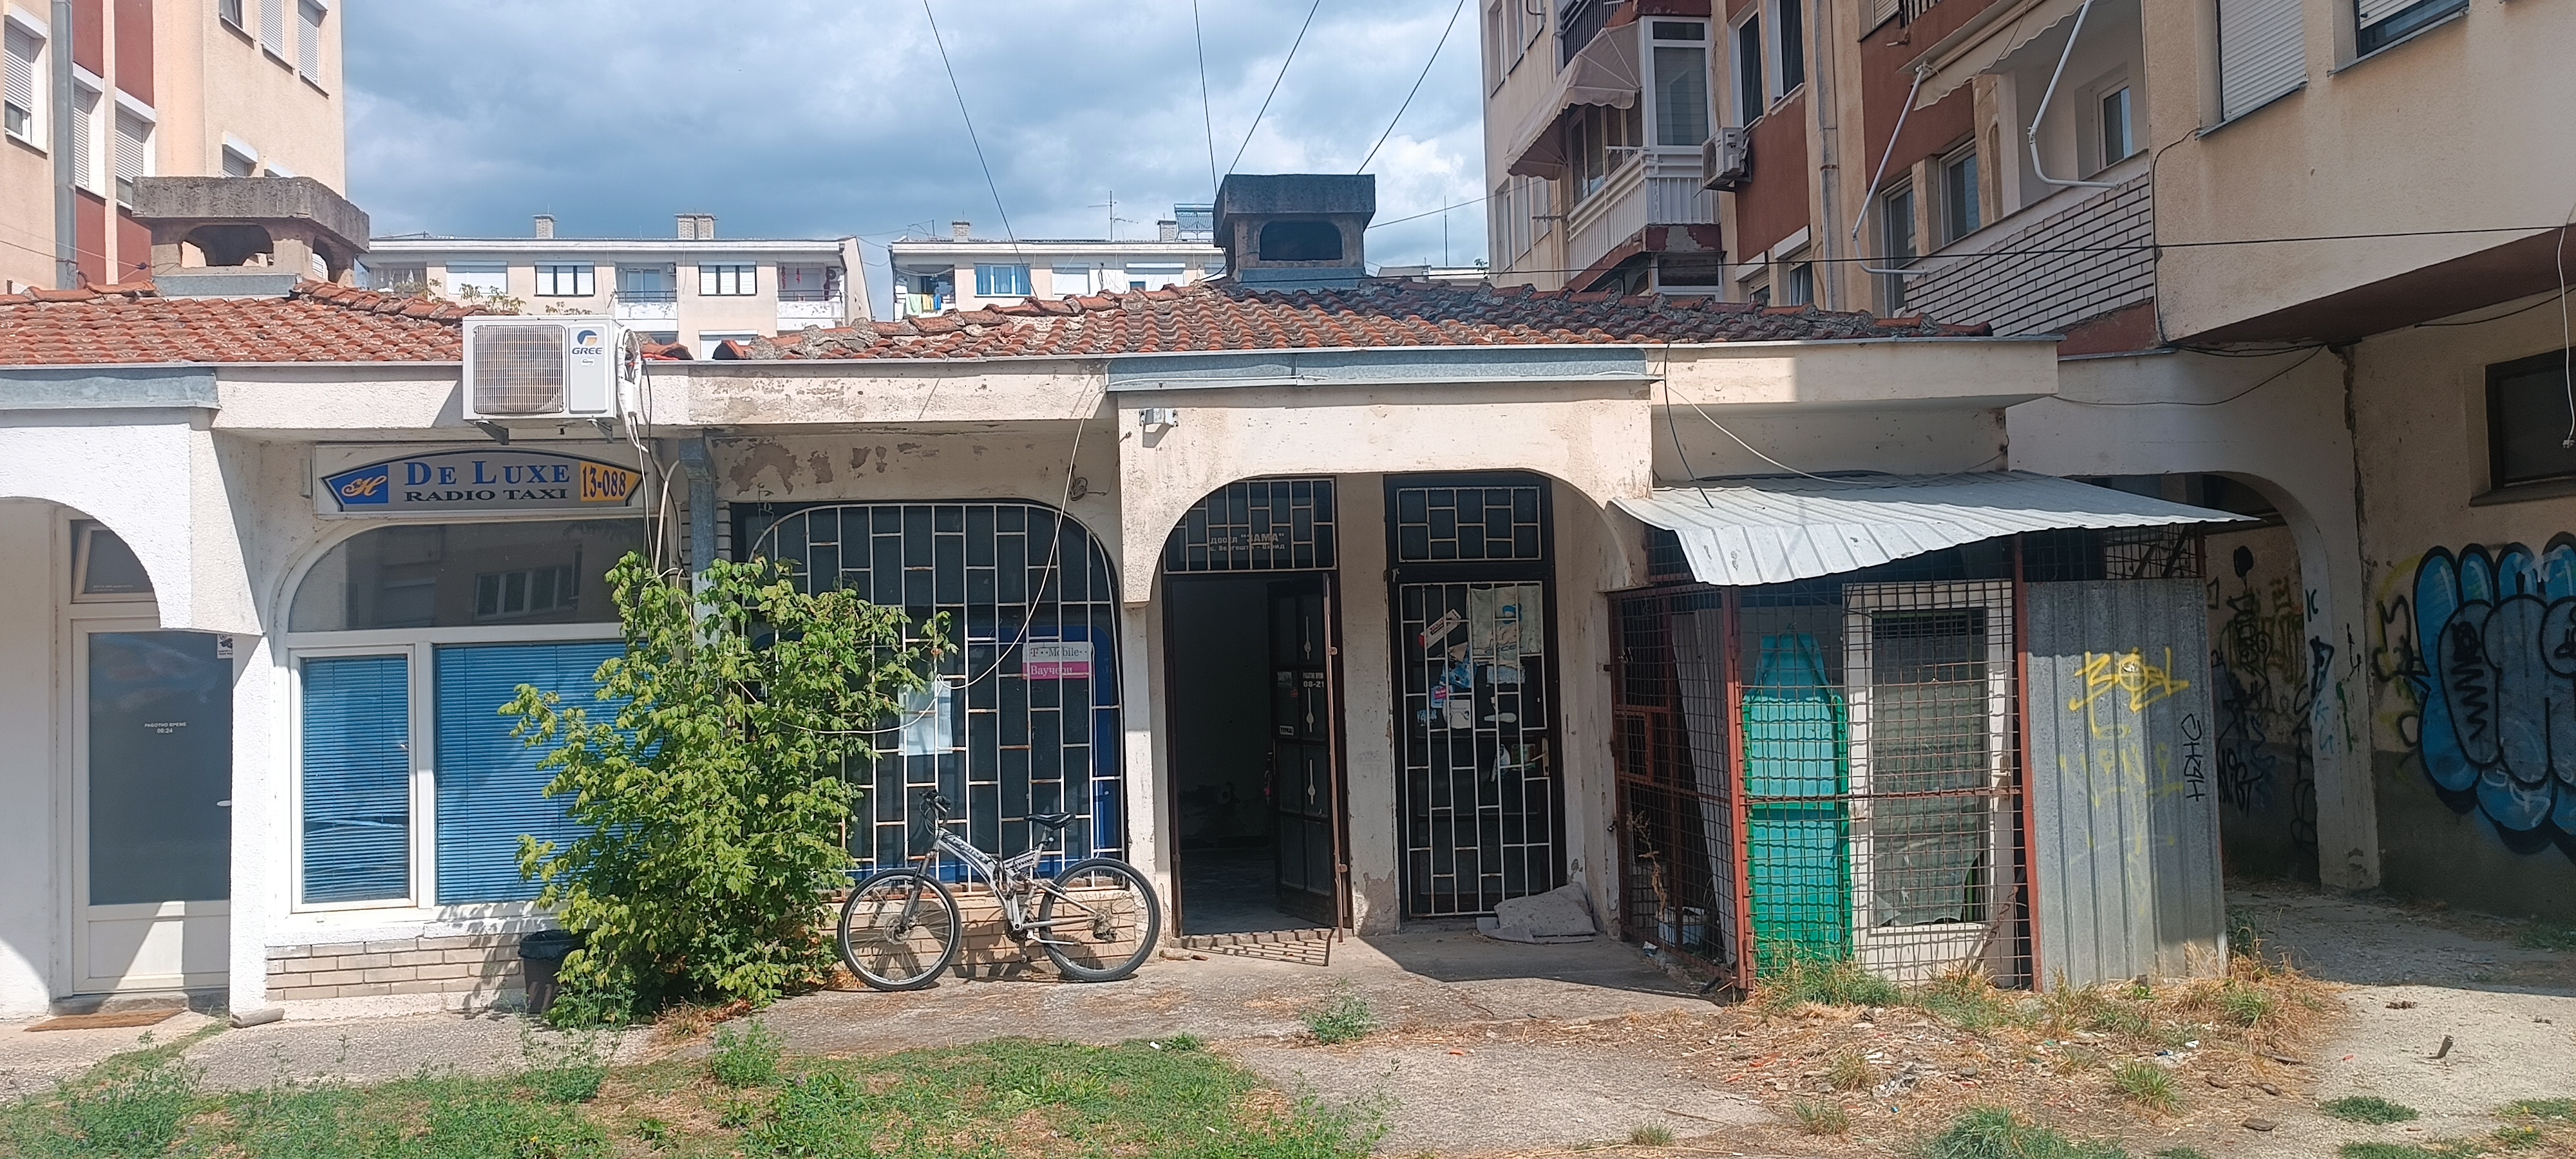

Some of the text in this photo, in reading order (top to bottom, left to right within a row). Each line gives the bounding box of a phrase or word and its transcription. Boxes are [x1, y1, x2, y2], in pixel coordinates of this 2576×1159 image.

[582, 465, 627, 498] 13-088
[404, 489, 568, 502] RADIO TAXI
